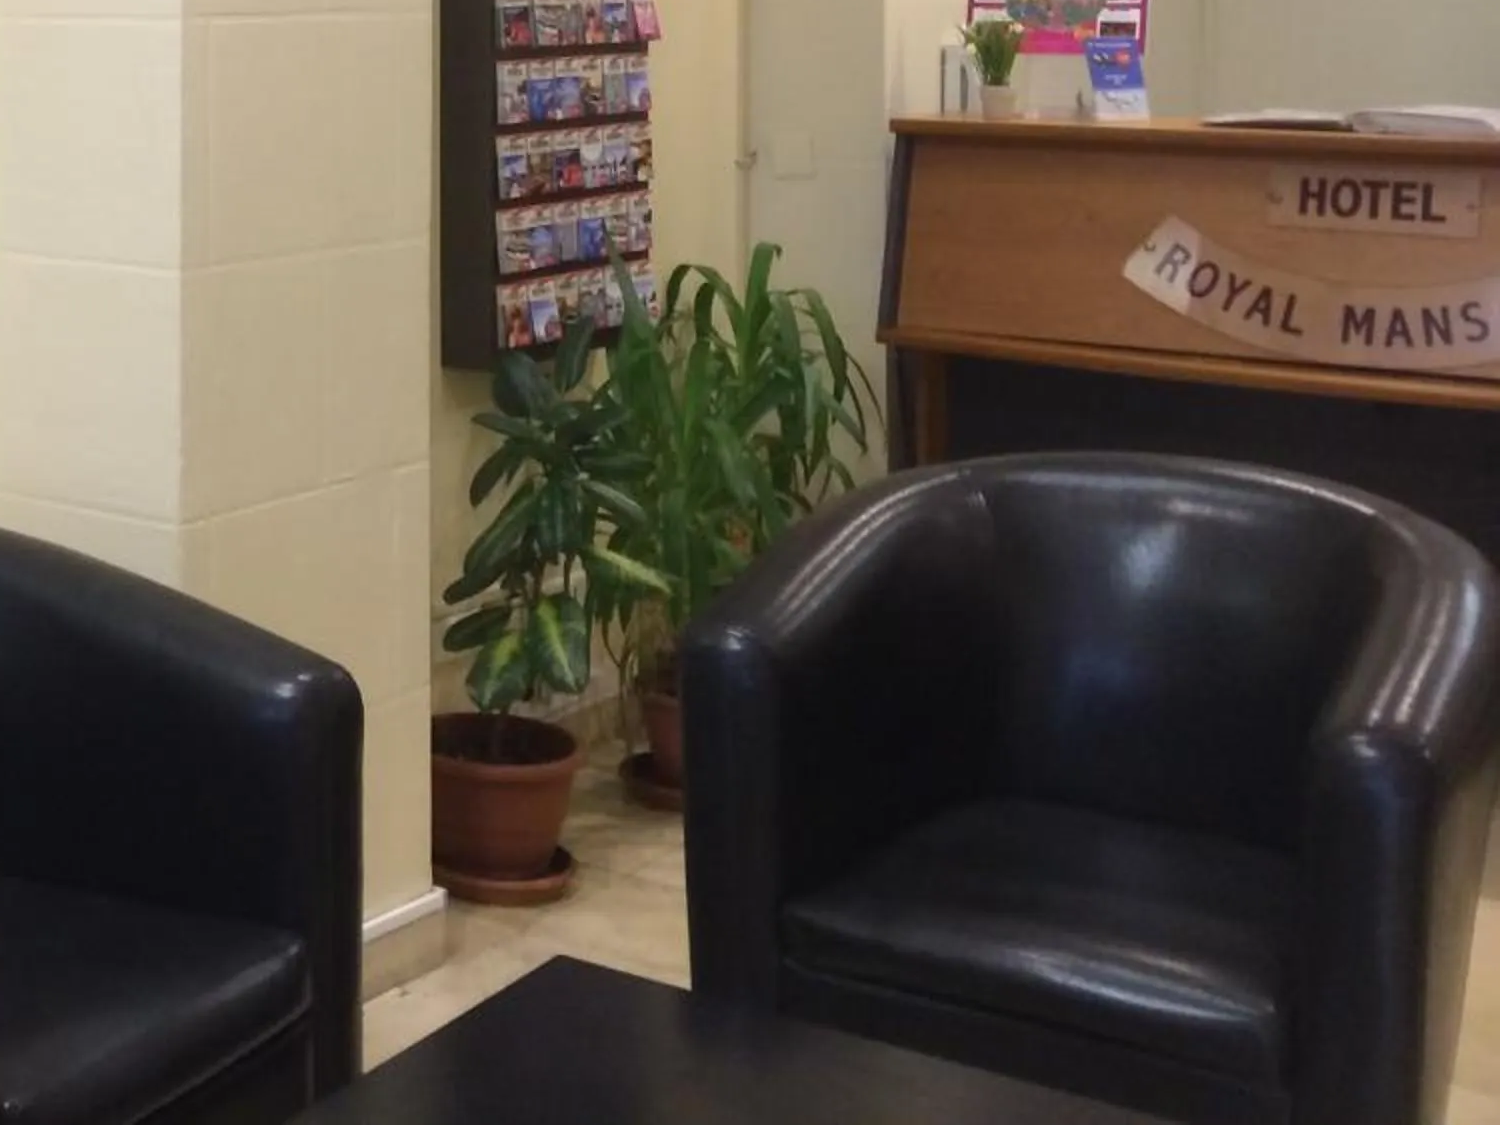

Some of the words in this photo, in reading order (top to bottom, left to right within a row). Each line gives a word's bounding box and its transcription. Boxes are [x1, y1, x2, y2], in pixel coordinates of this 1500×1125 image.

[1297, 175, 1447, 224] HOTEL
[1153, 241, 1305, 337] ROYAL
[1340, 300, 1490, 349] MANS
